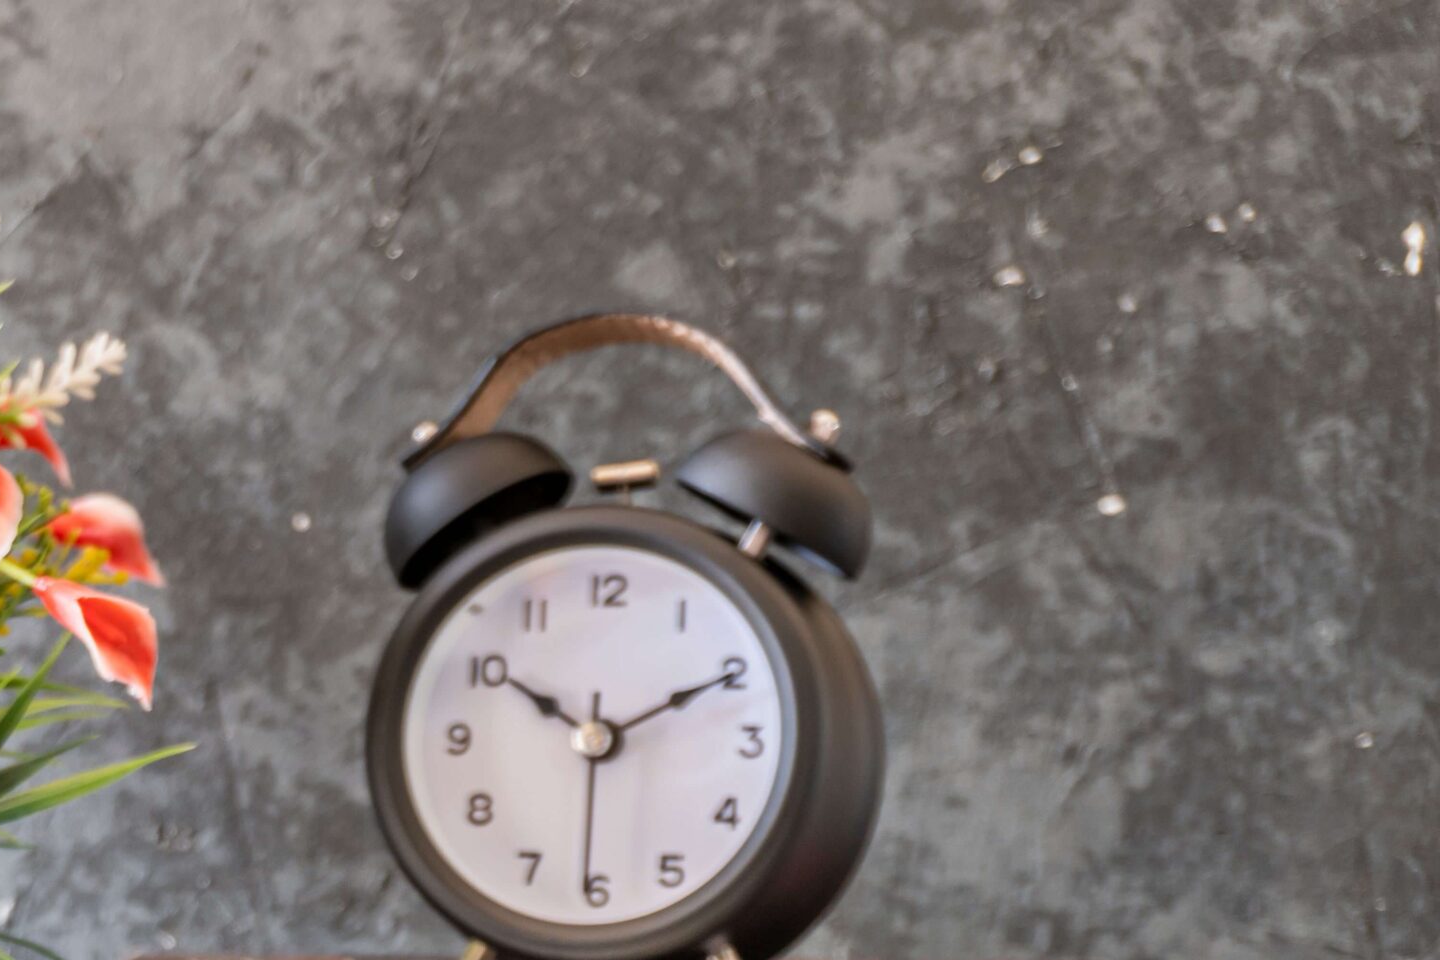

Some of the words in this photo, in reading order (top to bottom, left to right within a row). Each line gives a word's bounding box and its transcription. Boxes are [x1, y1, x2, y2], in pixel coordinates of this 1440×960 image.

[590, 573, 628, 608] 12
[521, 598, 548, 632] 11
[468, 653, 509, 688] 10
[722, 656, 748, 690] 2
[446, 722, 472, 757] 9
[739, 725, 766, 759] 3
[465, 792, 495, 827] 8
[712, 797, 741, 829] 4
[516, 850, 544, 886] 7
[658, 854, 686, 889] 5
[583, 874, 611, 908] 6
